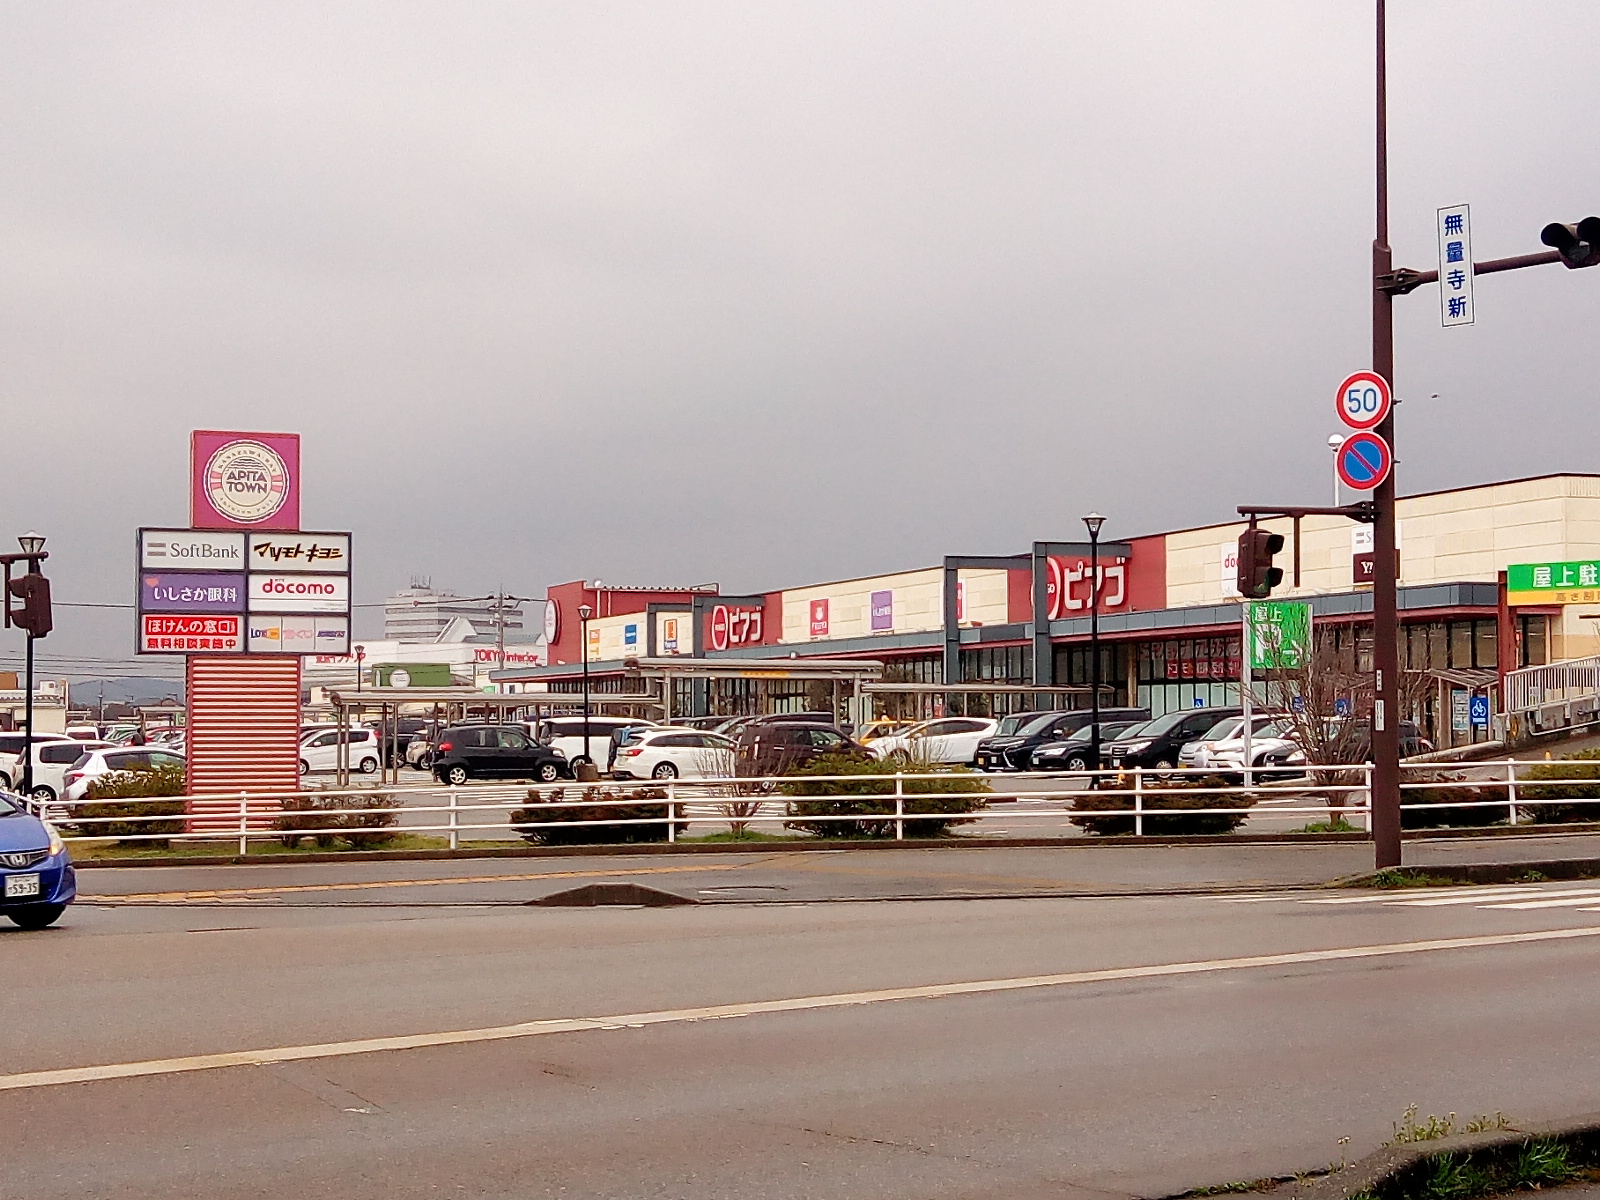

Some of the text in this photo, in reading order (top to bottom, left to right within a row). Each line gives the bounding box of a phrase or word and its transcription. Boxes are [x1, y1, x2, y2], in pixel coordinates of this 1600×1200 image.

[1444, 213, 1467, 318] 無量寺新
[1347, 387, 1377, 413] 50
[226, 470, 268, 483] APITA
[226, 481, 268, 494] TOWN
[170, 542, 240, 559] SoftBank
[253, 541, 344, 563] マツモトキヨシ
[262, 578, 335, 595] docomo
[1064, 556, 1126, 610] ピアゴ
[153, 587, 238, 603] いしさか眼科
[1255, 606, 1282, 622] 屋上
[148, 619, 236, 635] ほけんの窓口
[729, 605, 762, 643] ピアゴ
